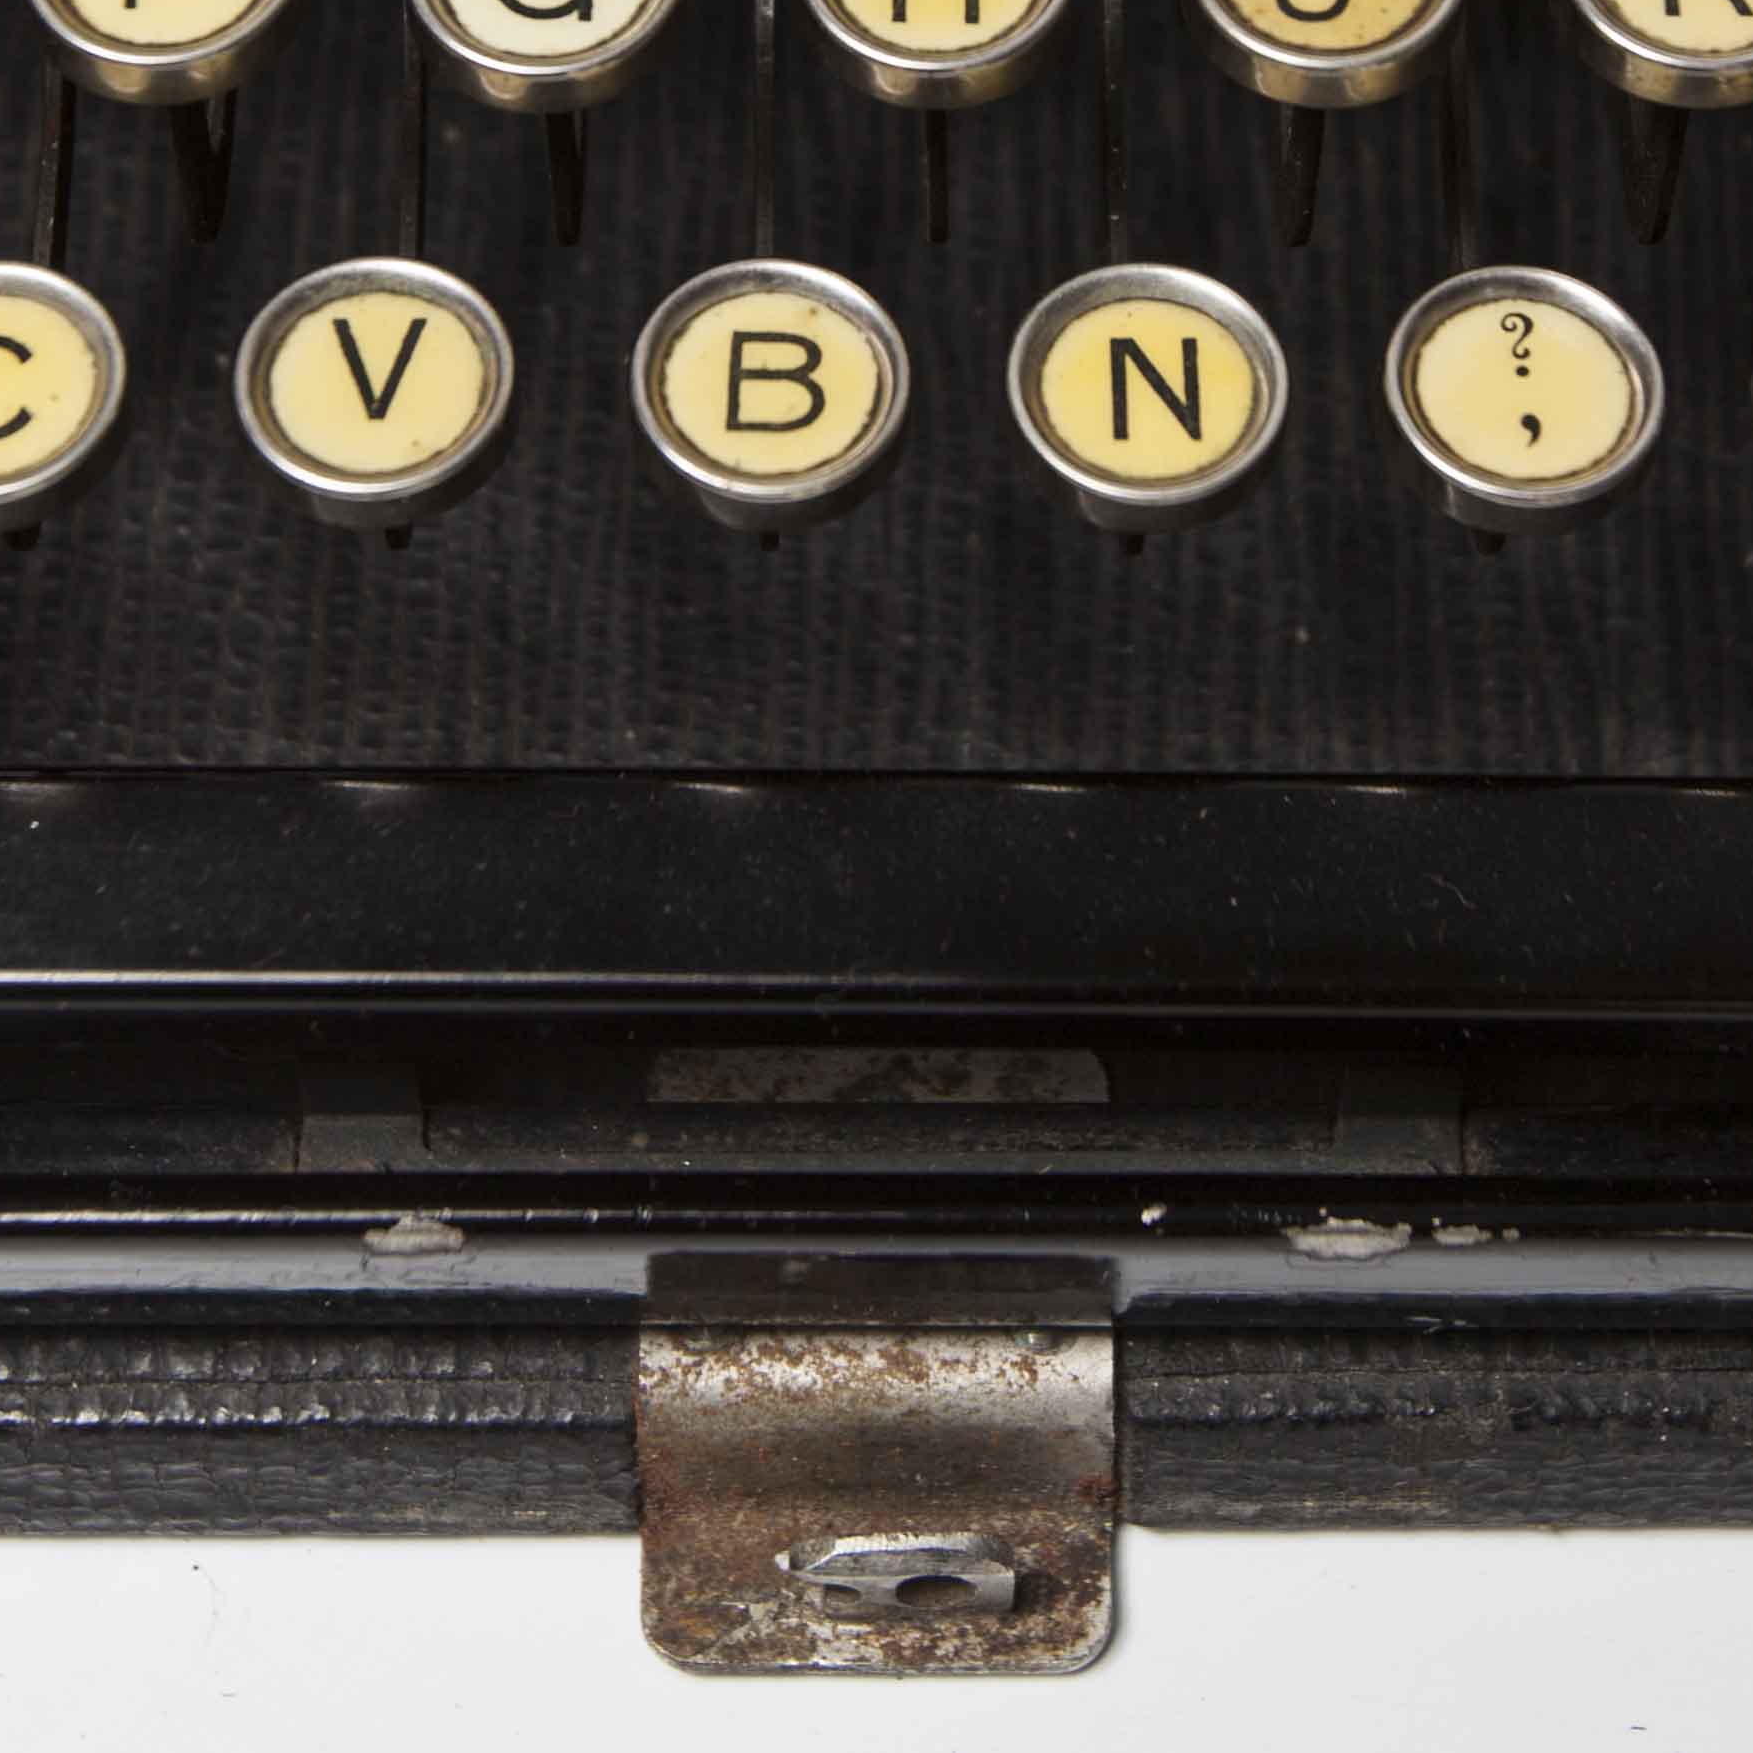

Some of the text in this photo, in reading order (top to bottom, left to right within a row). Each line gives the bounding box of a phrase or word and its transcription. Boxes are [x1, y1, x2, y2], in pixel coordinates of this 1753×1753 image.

[331, 317, 428, 421] V
[725, 330, 827, 434] B
[1108, 336, 1203, 442] N
[1500, 311, 1535, 378] ?
